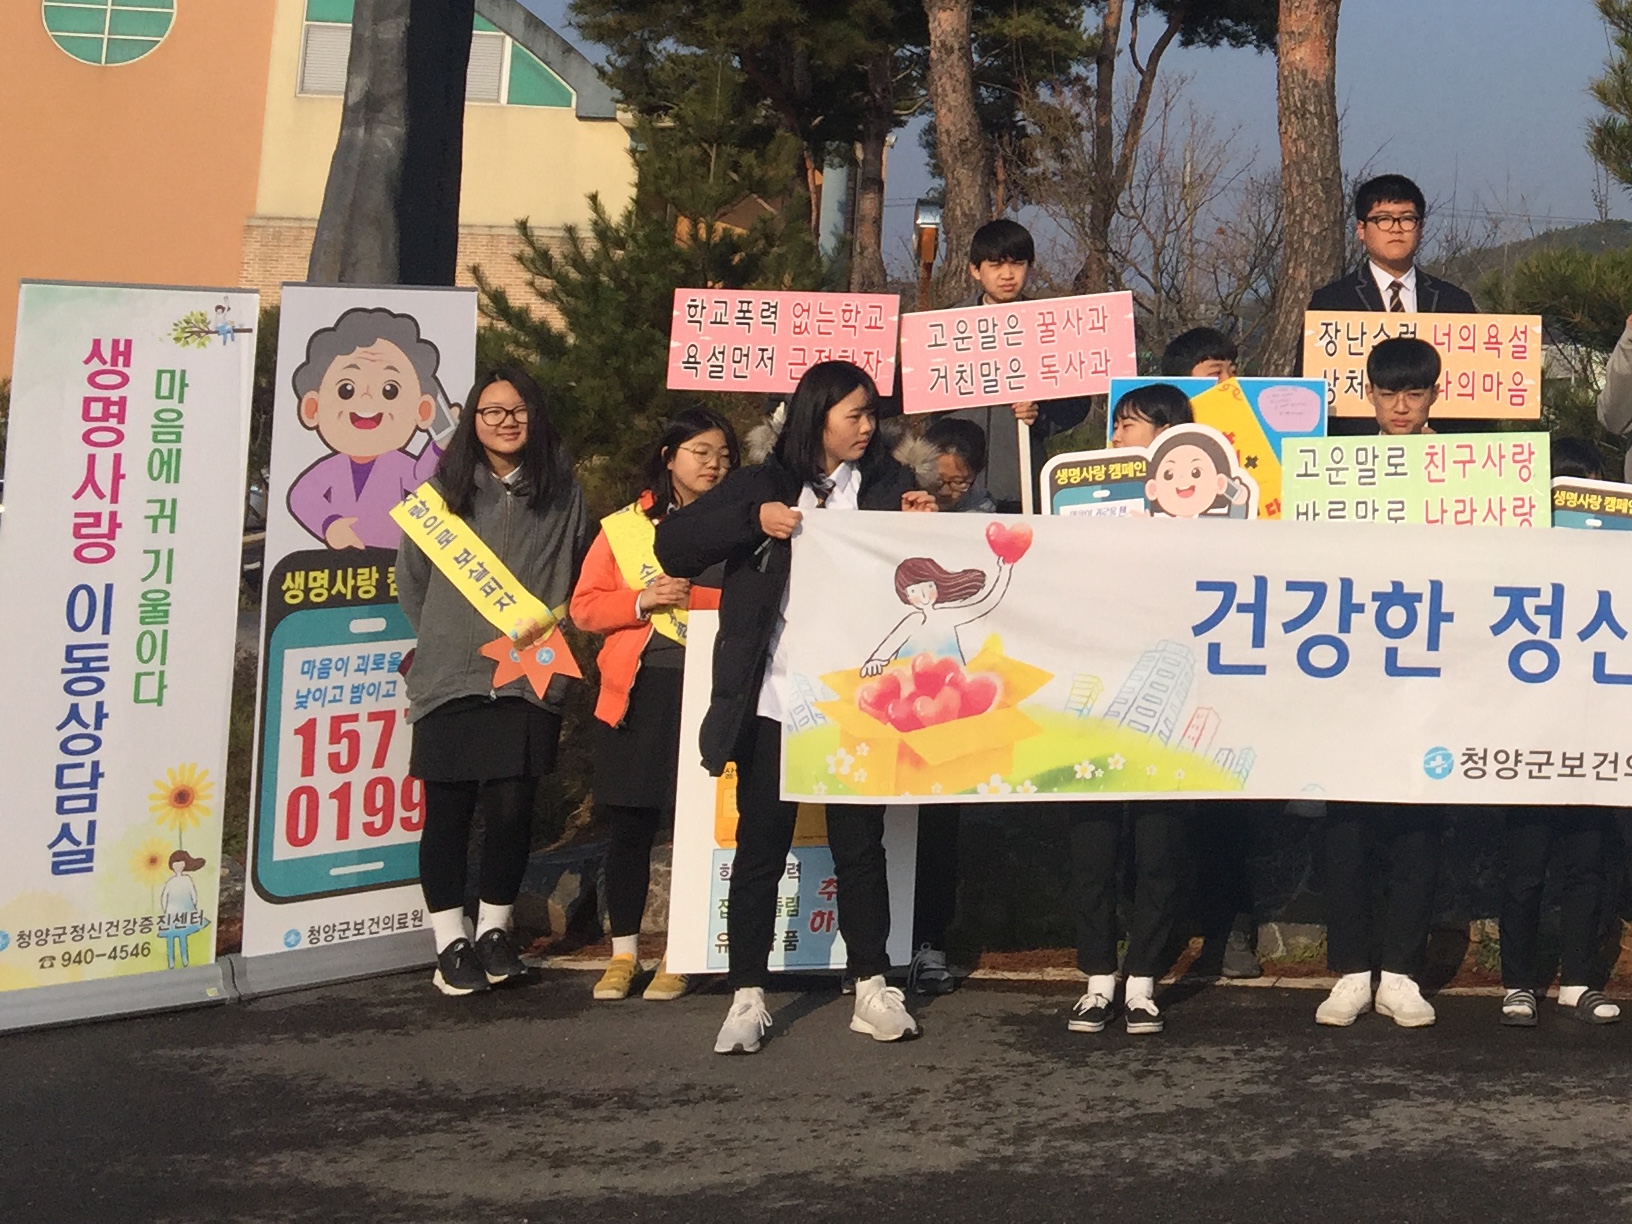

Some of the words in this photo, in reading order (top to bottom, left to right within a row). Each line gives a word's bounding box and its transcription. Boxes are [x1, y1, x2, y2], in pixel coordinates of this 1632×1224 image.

[685, 298, 779, 331] 학교폭력
[791, 301, 885, 336] 없는학교
[926, 311, 1024, 351] 고운말은
[1036, 307, 1108, 340] 꿀사과
[1433, 323, 1529, 360] 너의욕설
[681, 344, 776, 380] 욕설먼저
[929, 359, 1027, 396] 거친말은
[1039, 351, 1111, 382] 독사과
[147, 368, 190, 485] 마음에
[71, 338, 133, 565] 생명사랑
[1296, 445, 1408, 486] 고운말로
[1424, 442, 1536, 483] 친구사랑
[1054, 464, 1106, 485] 생명사랑
[144, 497, 178, 534] 귀
[1425, 496, 1536, 527] 나라사랑
[1553, 489, 1602, 511] 생명사랑
[281, 566, 379, 605] 생명사랑
[453, 547, 518, 612] 보살피자
[133, 547, 175, 707] 기울이다
[1191, 575, 1455, 680] 건강한
[300, 656, 351, 681] 마음이
[353, 651, 403, 675] 괴로울
[349, 680, 397, 705] 밤이고
[47, 582, 115, 876] 이동상담실
[293, 708, 410, 778] 157
[285, 775, 427, 848] 0199
[16, 910, 204, 949] 청양군정신건강증진센터
[307, 909, 424, 945] 청양군보건의료원
[61, 941, 151, 968] 940-4546
